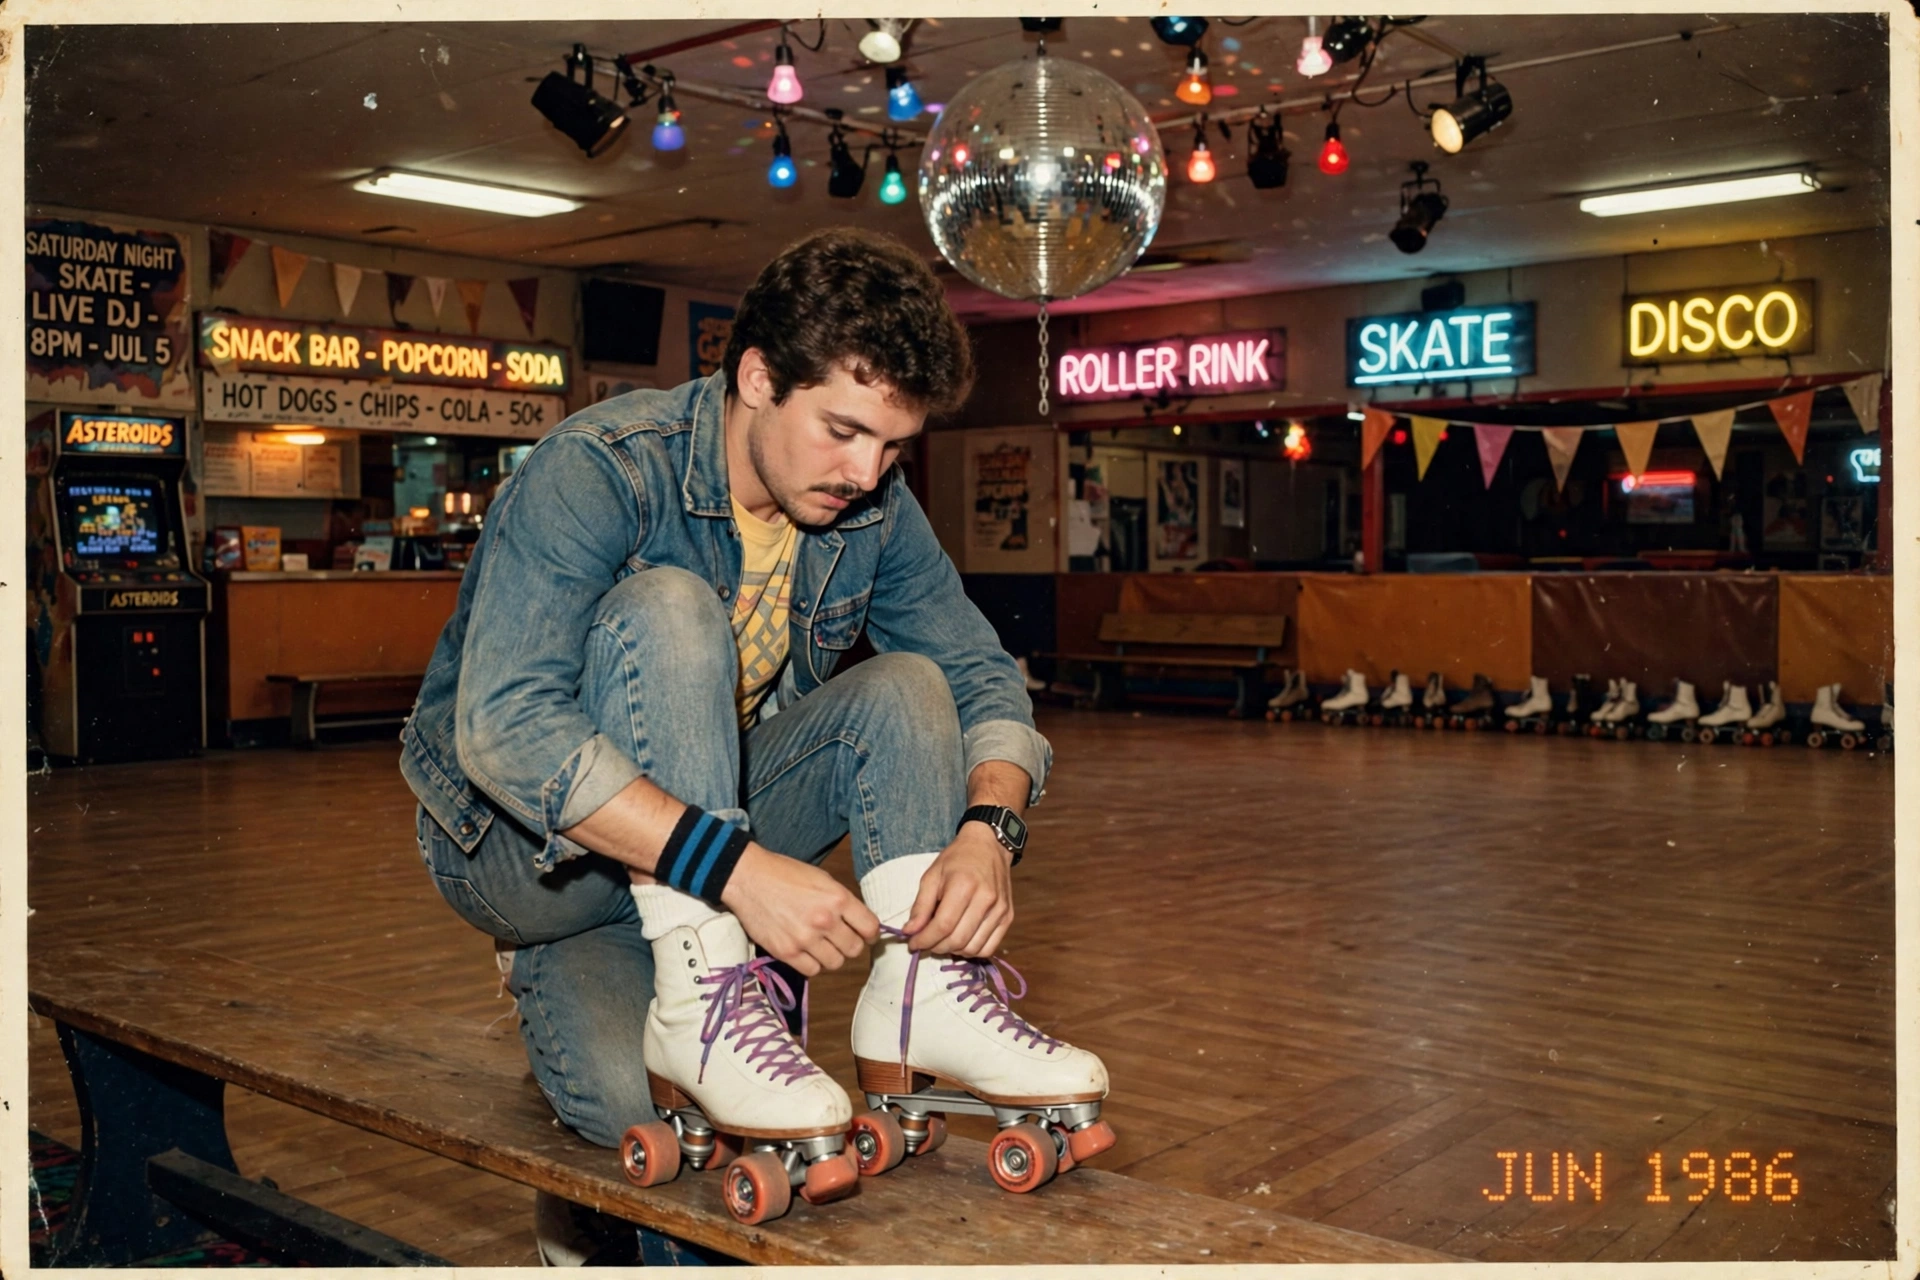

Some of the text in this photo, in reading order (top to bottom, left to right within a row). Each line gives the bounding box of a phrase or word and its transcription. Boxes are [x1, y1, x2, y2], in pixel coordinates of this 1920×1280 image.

[26, 231, 176, 271] SATURDAY NIGHT
[59, 262, 134, 295] SKATE
[32, 291, 95, 325] LIVE
[107, 299, 141, 329] DJ
[1630, 291, 1798, 357] DISCO
[30, 327, 82, 358] 8PM
[104, 333, 148, 363] JUL
[155, 338, 171, 365] 5
[211, 326, 302, 365] SNACK
[309, 333, 360, 370] BAR
[382, 339, 489, 380] POPCORN
[505, 351, 564, 386] SODA
[1358, 312, 1512, 374] SKATE
[1059, 338, 1270, 396] ROLLER RINK
[222, 382, 267, 410] HOT
[279, 385, 338, 414] DOGS
[360, 391, 420, 420] CHIPS
[440, 397, 490, 423] COLA
[509, 400, 544, 427] 50¢
[66, 418, 174, 447] ASTEROIDS
[110, 590, 179, 608] ASTEROIDS
